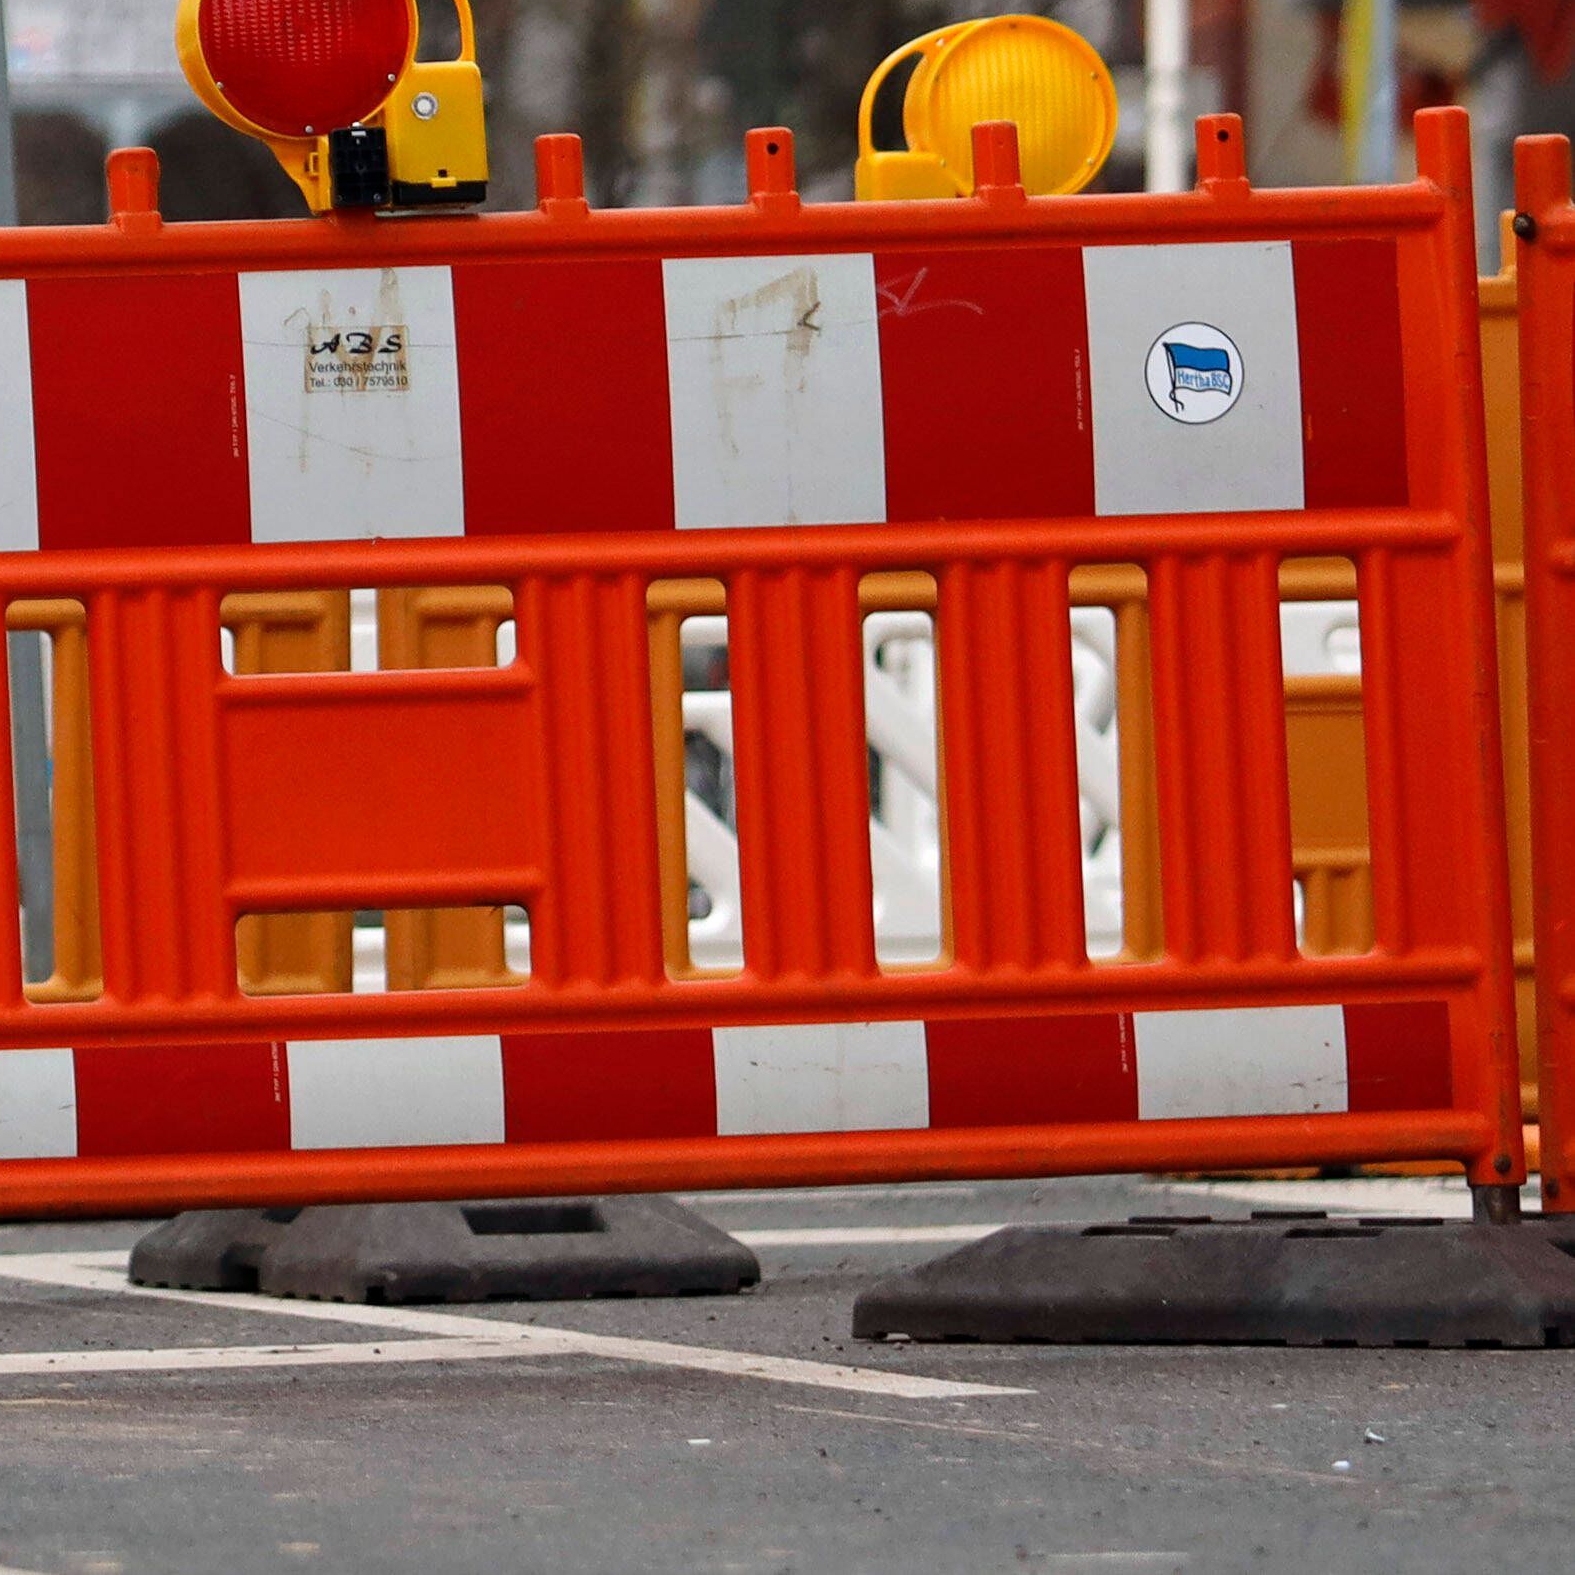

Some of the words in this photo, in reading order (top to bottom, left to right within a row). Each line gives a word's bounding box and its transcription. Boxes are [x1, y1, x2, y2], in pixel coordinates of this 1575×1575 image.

[309, 360, 407, 375] Verkehrstechnik
[1177, 370, 1211, 388] Hertha
[1210, 372, 1229, 390] BSC
